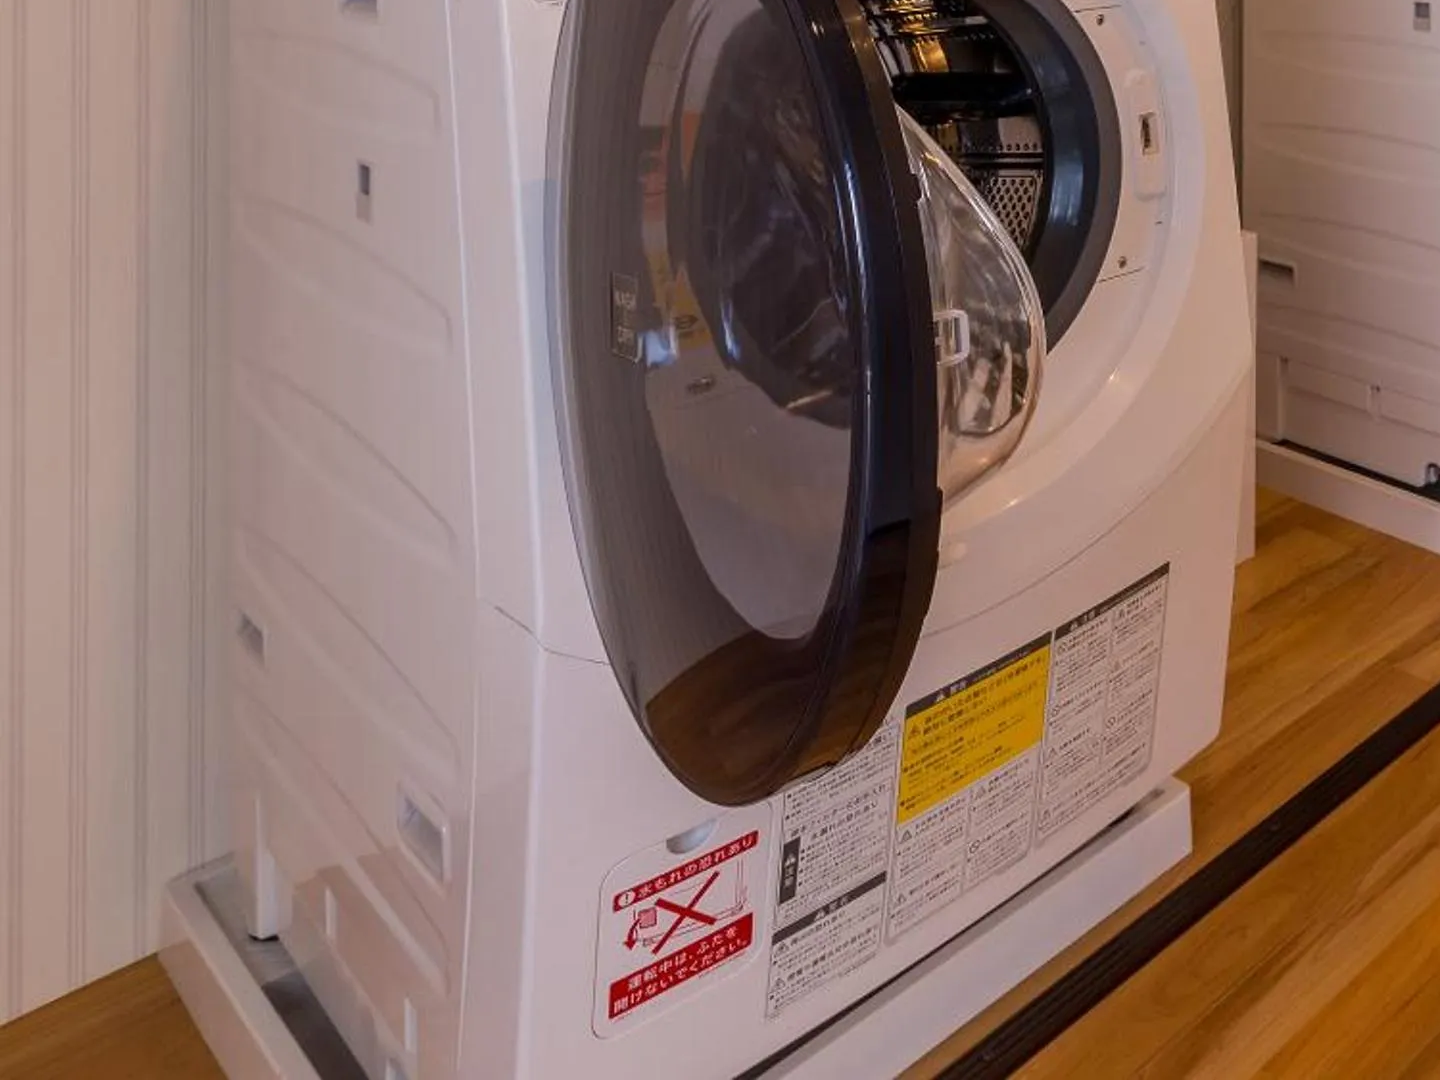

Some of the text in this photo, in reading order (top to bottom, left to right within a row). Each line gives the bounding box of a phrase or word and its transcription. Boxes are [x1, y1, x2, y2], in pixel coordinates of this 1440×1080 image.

[637, 834, 755, 899] 水もれの恐れあり
[612, 938, 749, 1015] 開けないでください。
[626, 925, 739, 992] 運転中は、ふたを
